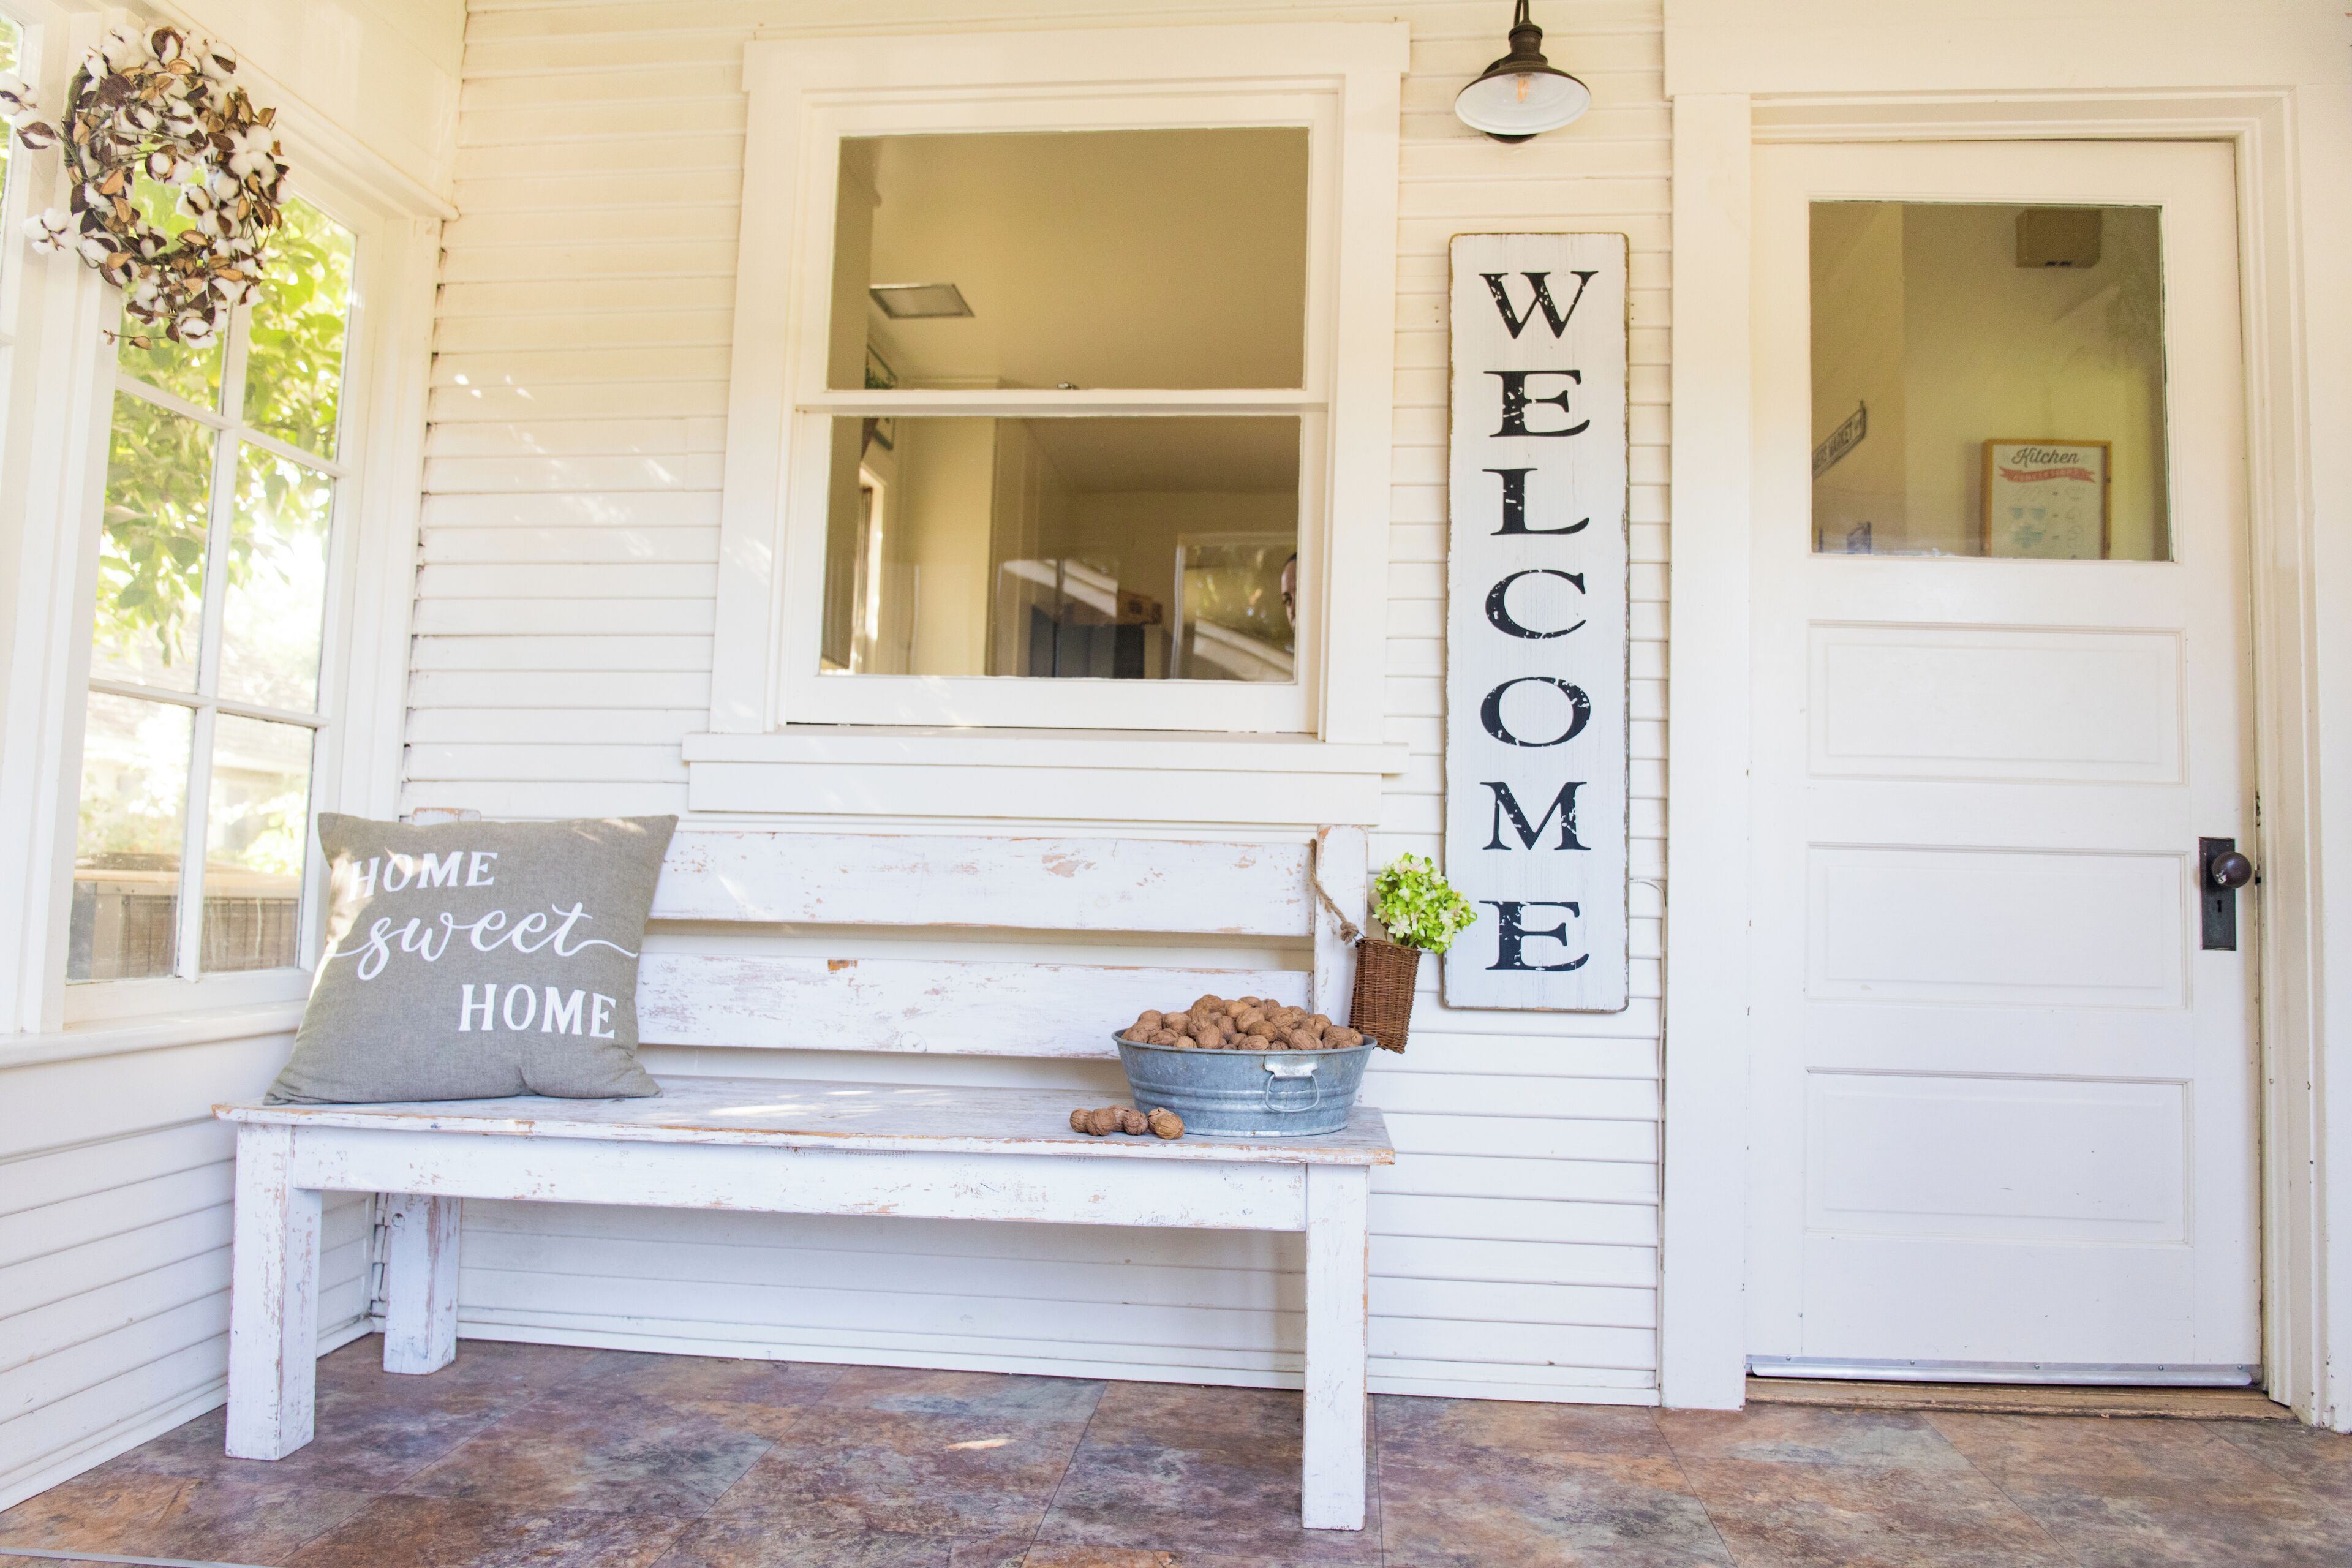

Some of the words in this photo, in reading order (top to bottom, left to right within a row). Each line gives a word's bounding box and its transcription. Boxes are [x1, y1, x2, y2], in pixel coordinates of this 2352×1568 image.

[2011, 447, 2080, 468] Kitchen
[1479, 271, 1598, 971] WELCOME
[347, 851, 498, 902] HOME
[326, 902, 638, 981] sweet
[458, 984, 616, 1038] HOME
